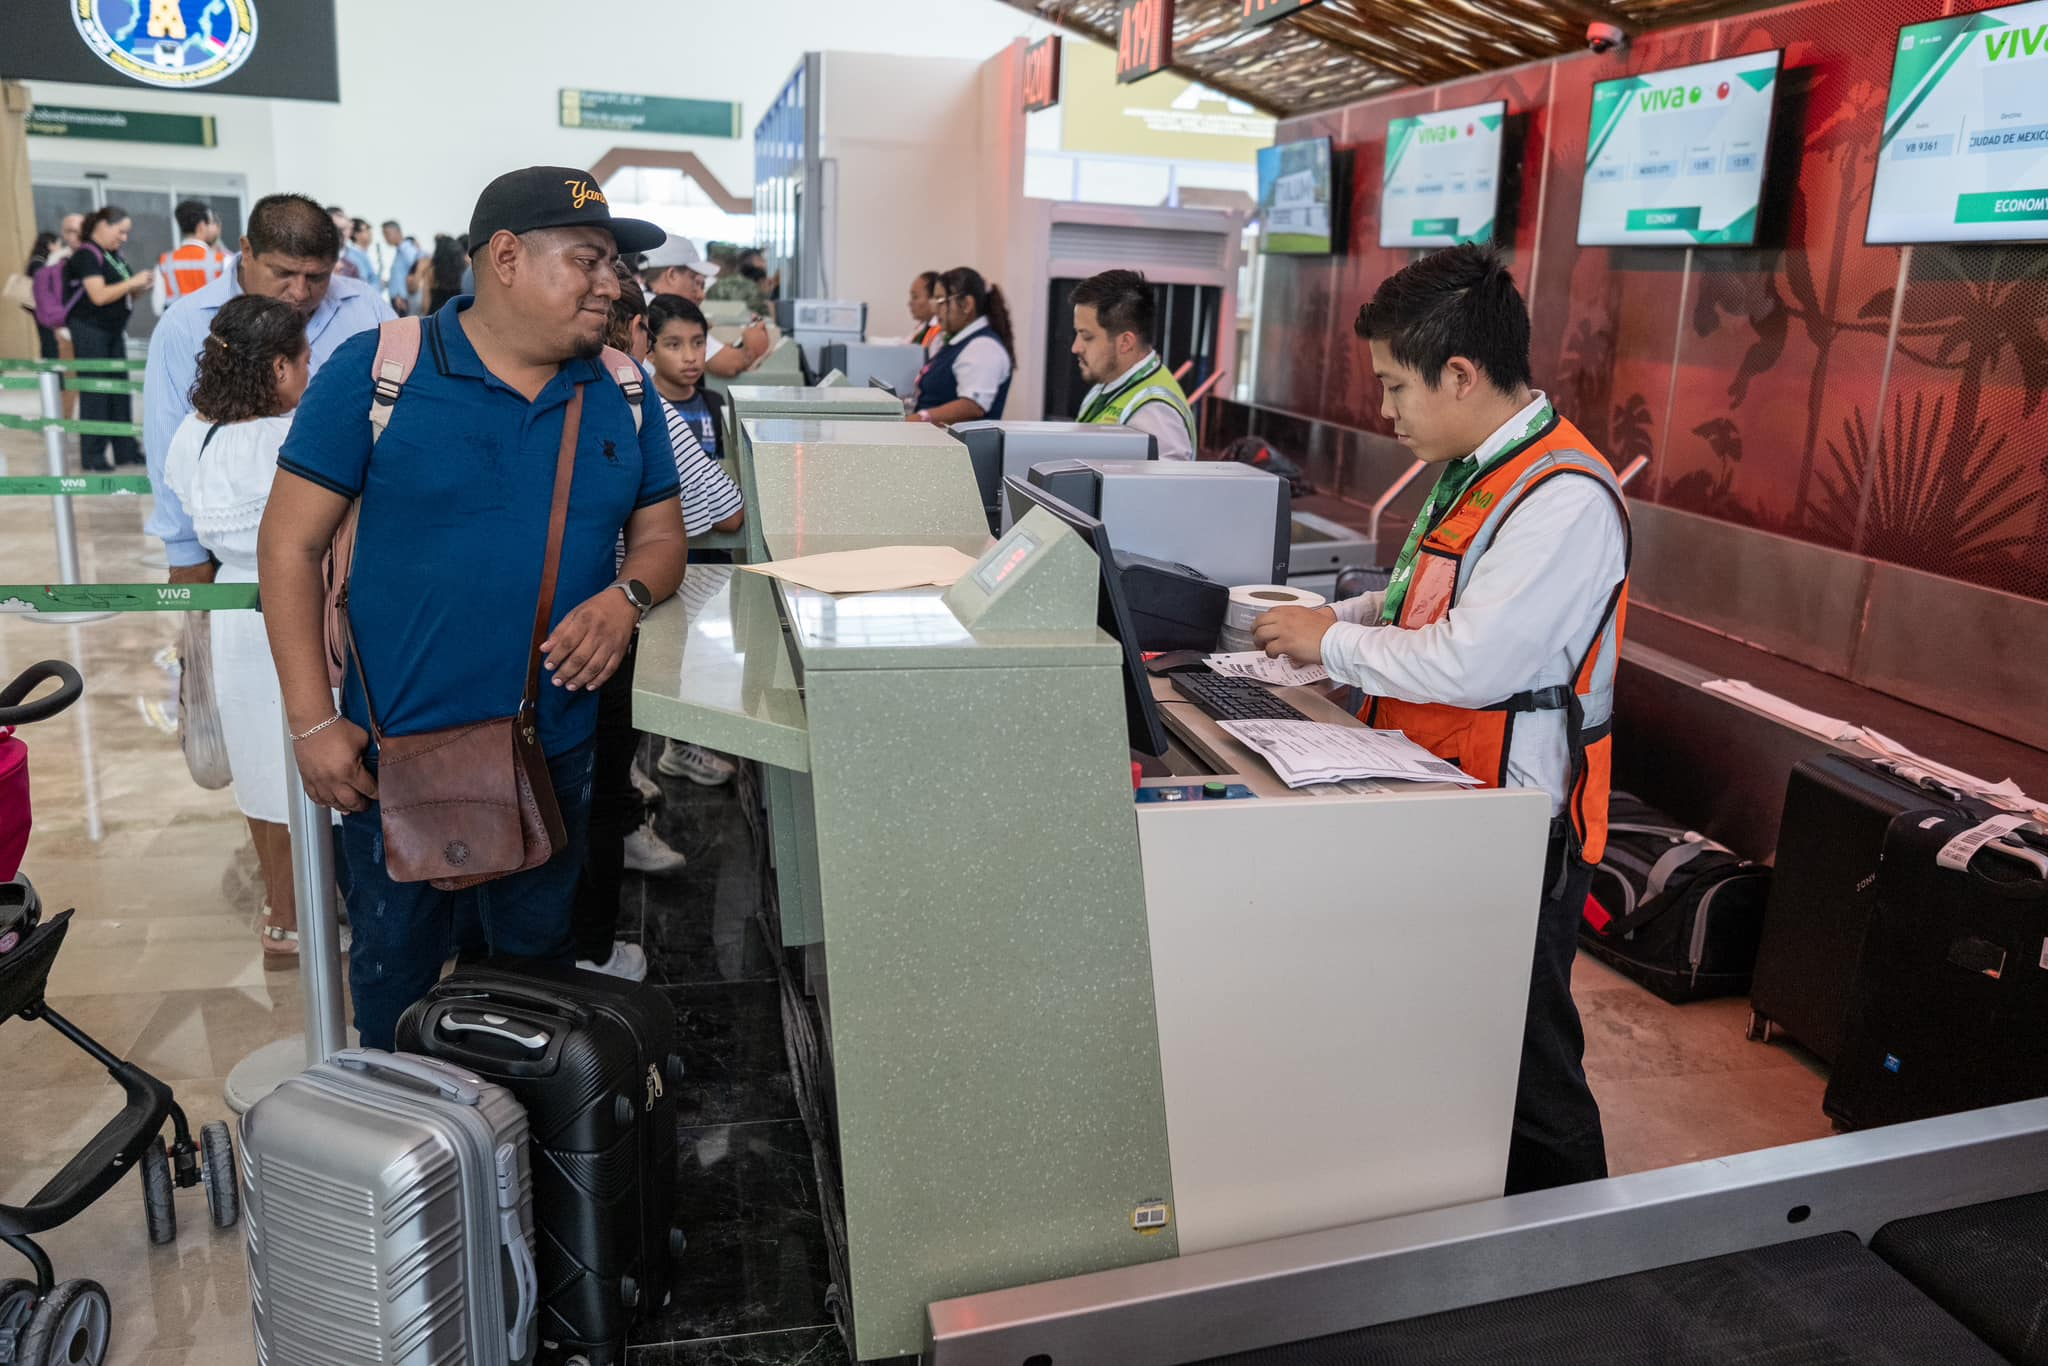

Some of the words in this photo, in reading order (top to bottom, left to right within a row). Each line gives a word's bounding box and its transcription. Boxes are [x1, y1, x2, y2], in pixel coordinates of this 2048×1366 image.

[1118, 0, 1152, 75] A19
[1641, 87, 1685, 113] viva
[2003, 133, 2016, 144] DE
[1906, 144, 1917, 153] VB
[1918, 141, 1938, 151] 9361
[564, 180, 607, 208] Yan
[60, 478, 87, 488] viva
[157, 587, 191, 600] viva
